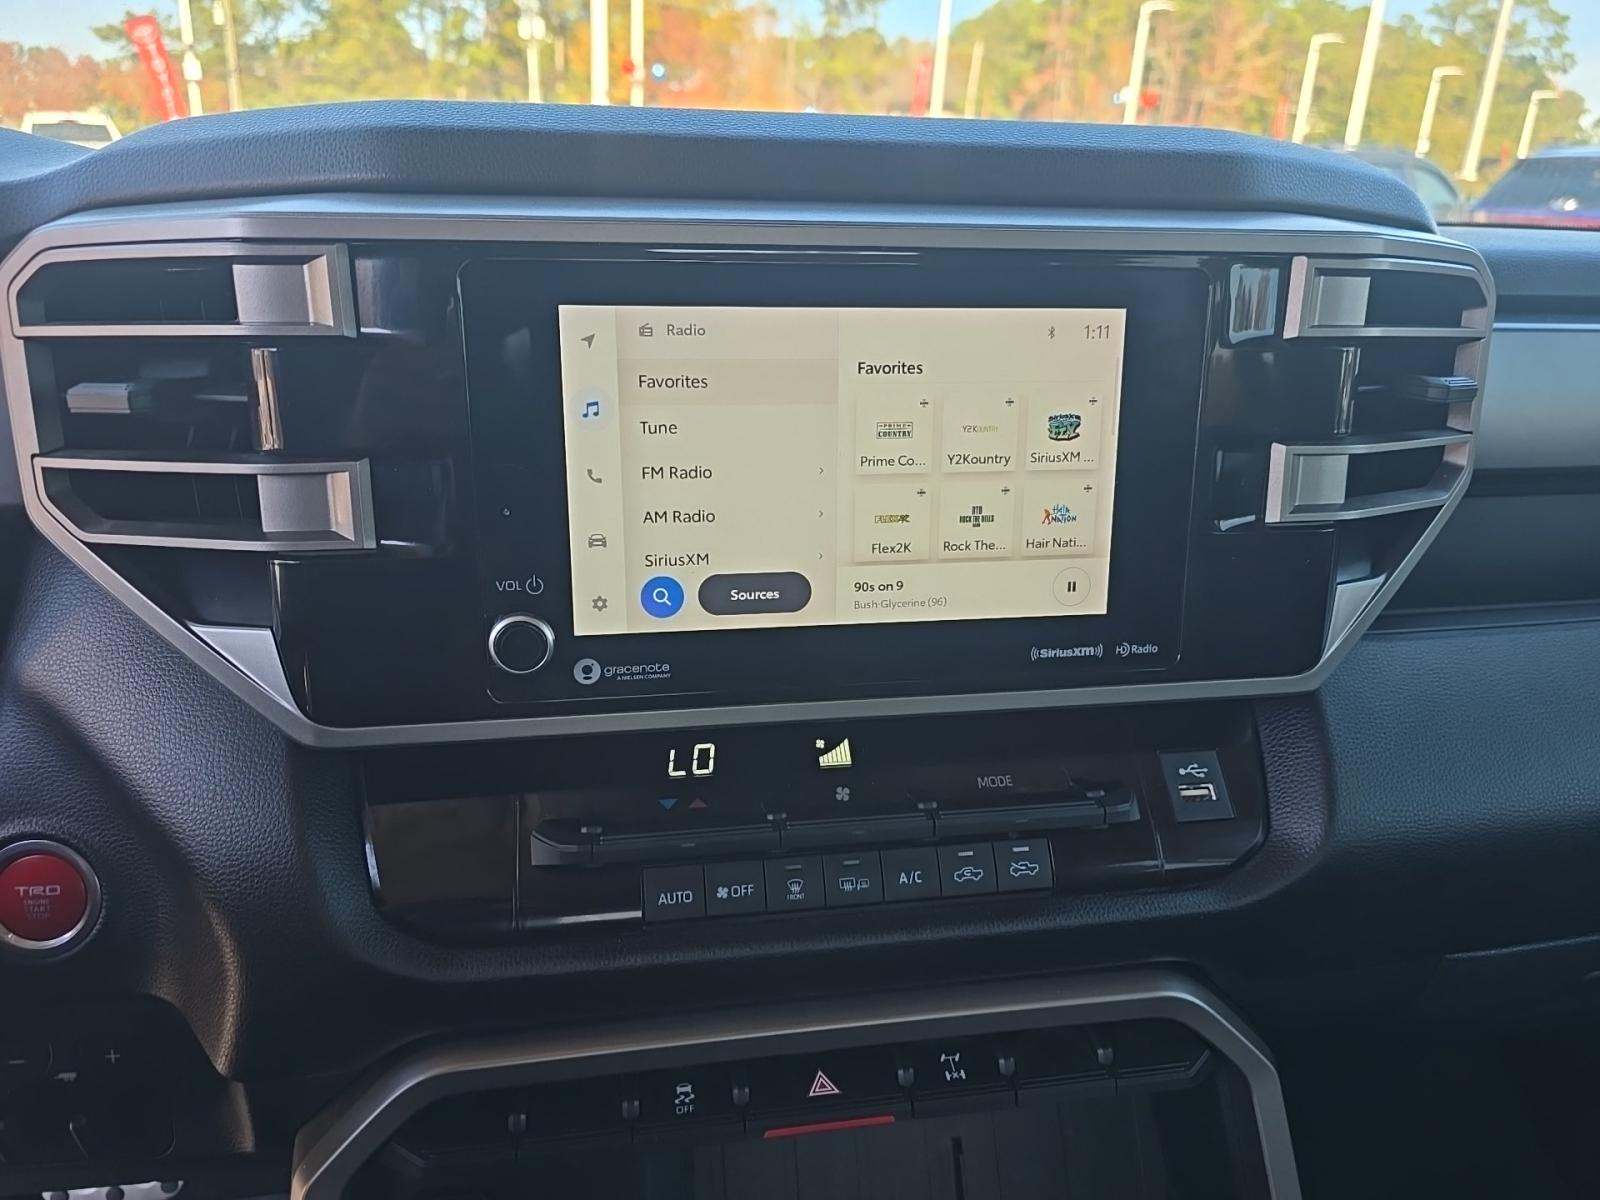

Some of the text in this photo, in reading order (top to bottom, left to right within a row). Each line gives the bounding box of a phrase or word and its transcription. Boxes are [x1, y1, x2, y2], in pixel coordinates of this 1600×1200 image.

[666, 323, 706, 336] Radio
[1084, 324, 1111, 340] 1:11
[857, 360, 923, 376] Favorites
[638, 374, 708, 390] Favorites
[640, 420, 678, 435] Tune
[860, 454, 926, 468] Prime Co...
[947, 453, 1011, 468] Y2Kountry
[1030, 451, 1081, 464] SiriusXM
[642, 465, 713, 480] FM Radio
[643, 509, 716, 524] AM Radio
[871, 541, 912, 556] Flex2K
[943, 539, 1006, 552] Rock The...
[1026, 537, 1087, 550] Hair Nati...
[645, 552, 710, 568] SiriusXM
[496, 579, 522, 592] VOL
[854, 580, 904, 592] 90s on 9
[730, 588, 780, 601] Sources
[928, 597, 947, 609] (96)
[1131, 643, 1158, 655] Radio
[603, 662, 670, 677] gracenote
[668, 742, 716, 778] LO
[977, 774, 1014, 790] MODE
[898, 868, 923, 885] A/C
[14, 885, 61, 897] TRD
[657, 889, 693, 906] AUTO
[730, 882, 755, 898] OFF
[675, 1104, 695, 1115] OFF
